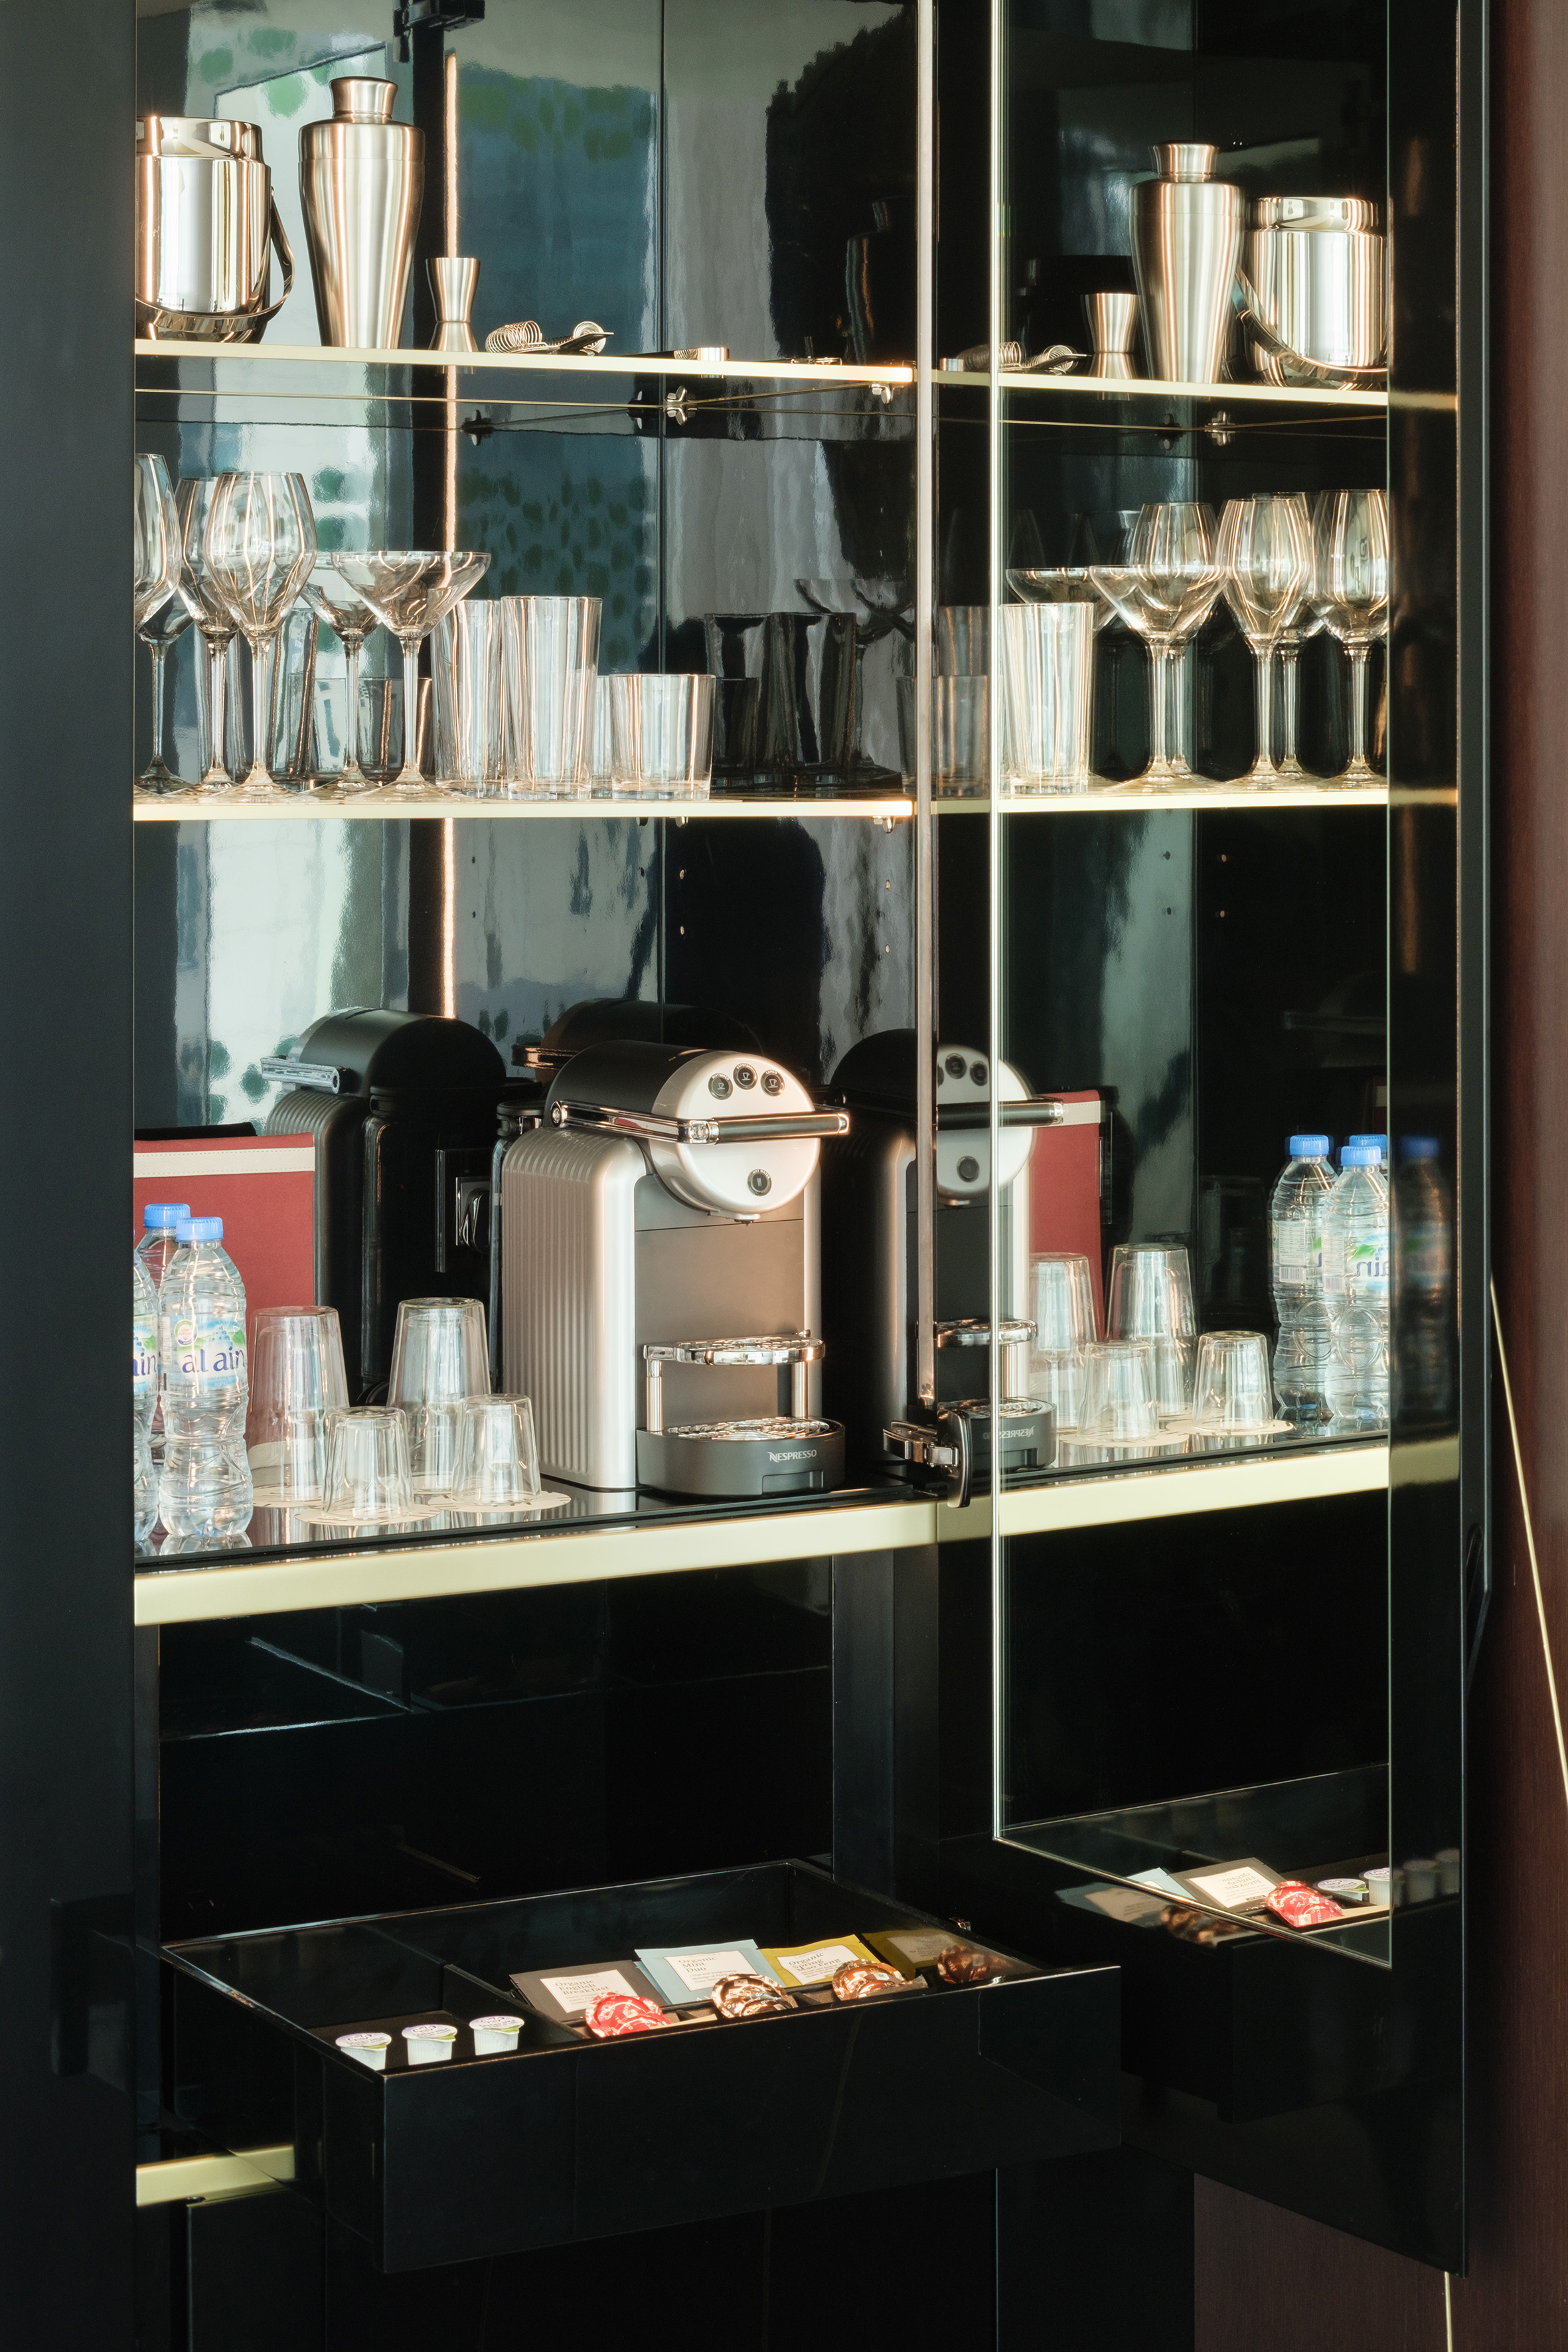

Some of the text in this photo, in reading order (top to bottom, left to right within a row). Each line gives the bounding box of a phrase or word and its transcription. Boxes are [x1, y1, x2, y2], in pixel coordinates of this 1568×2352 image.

[182, 1346, 245, 1373] al ain
[767, 1449, 817, 1462] NESPRESSO
[789, 1952, 824, 1965] Organic
[793, 1959, 824, 1970] Spring
[563, 1986, 609, 1995] Breakfast
